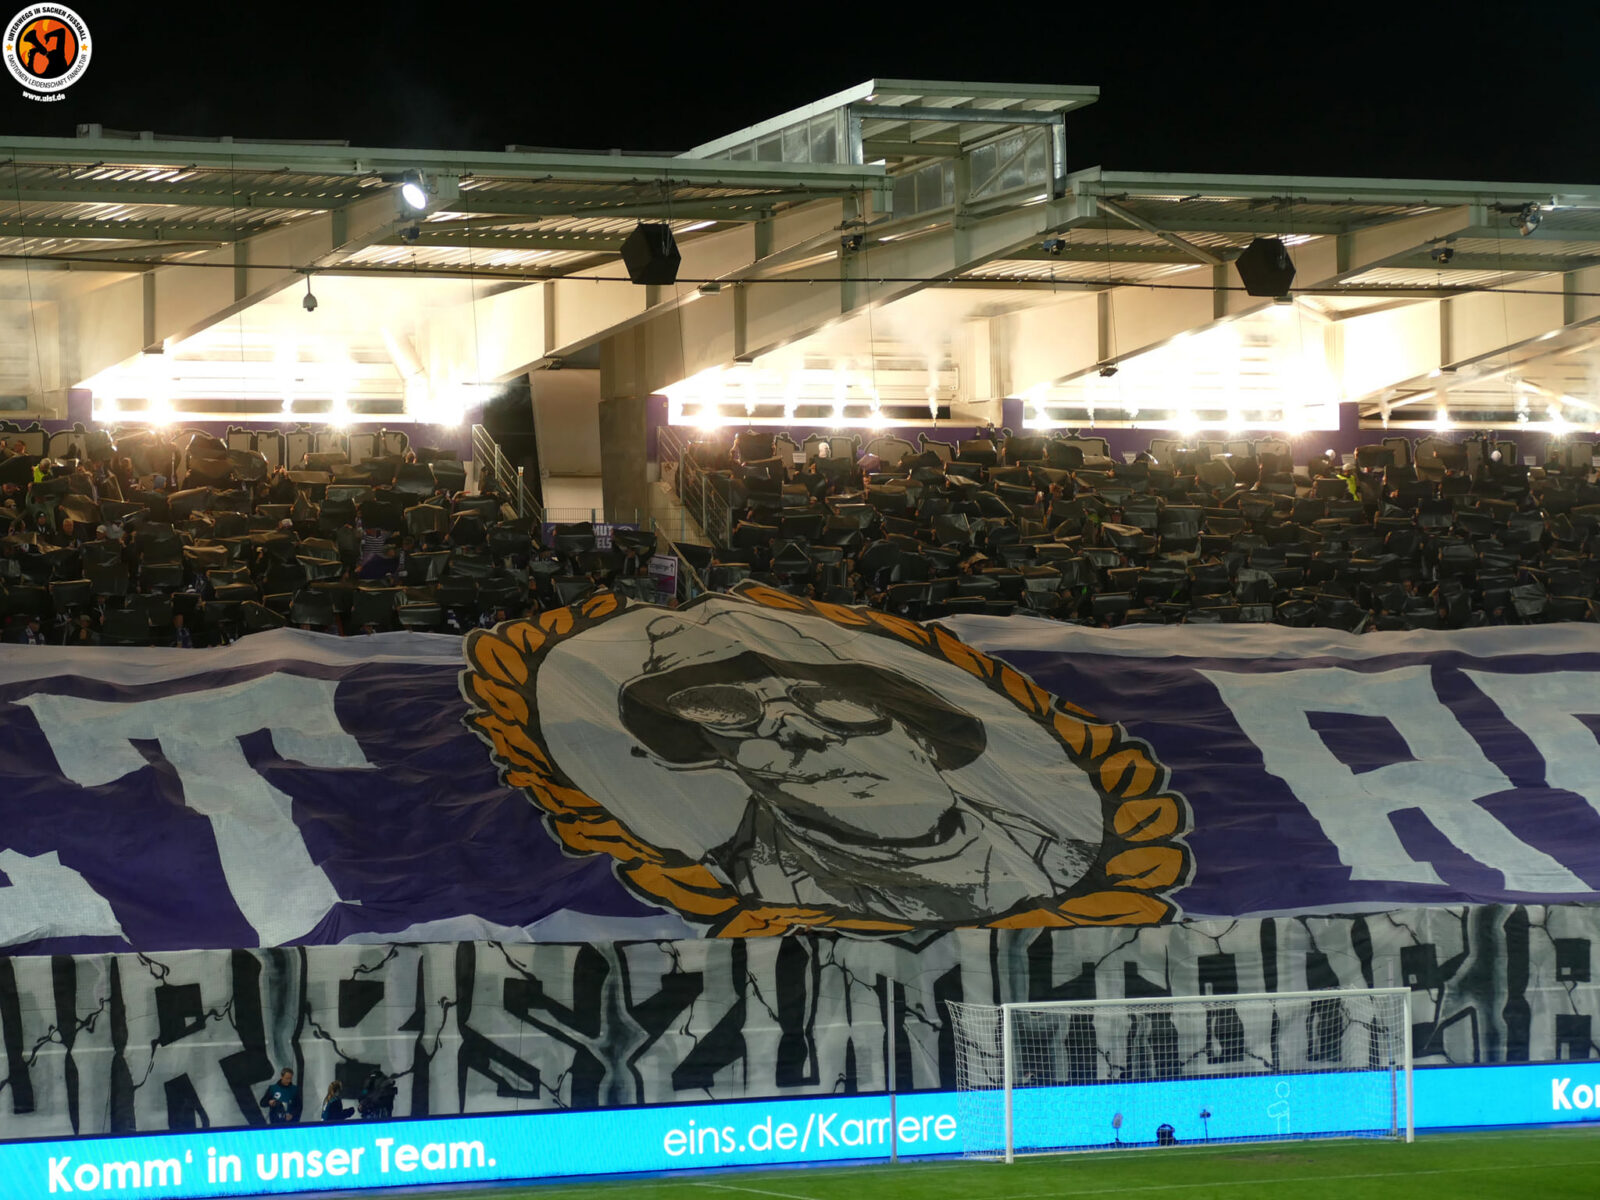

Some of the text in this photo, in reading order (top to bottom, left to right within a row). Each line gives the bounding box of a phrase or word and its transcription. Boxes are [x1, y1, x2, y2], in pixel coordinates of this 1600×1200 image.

[663, 1113, 957, 1156] eins.de/Karrere
[207, 1146, 242, 1184] in
[256, 1145, 366, 1181] unser
[375, 1137, 498, 1174] Team.
